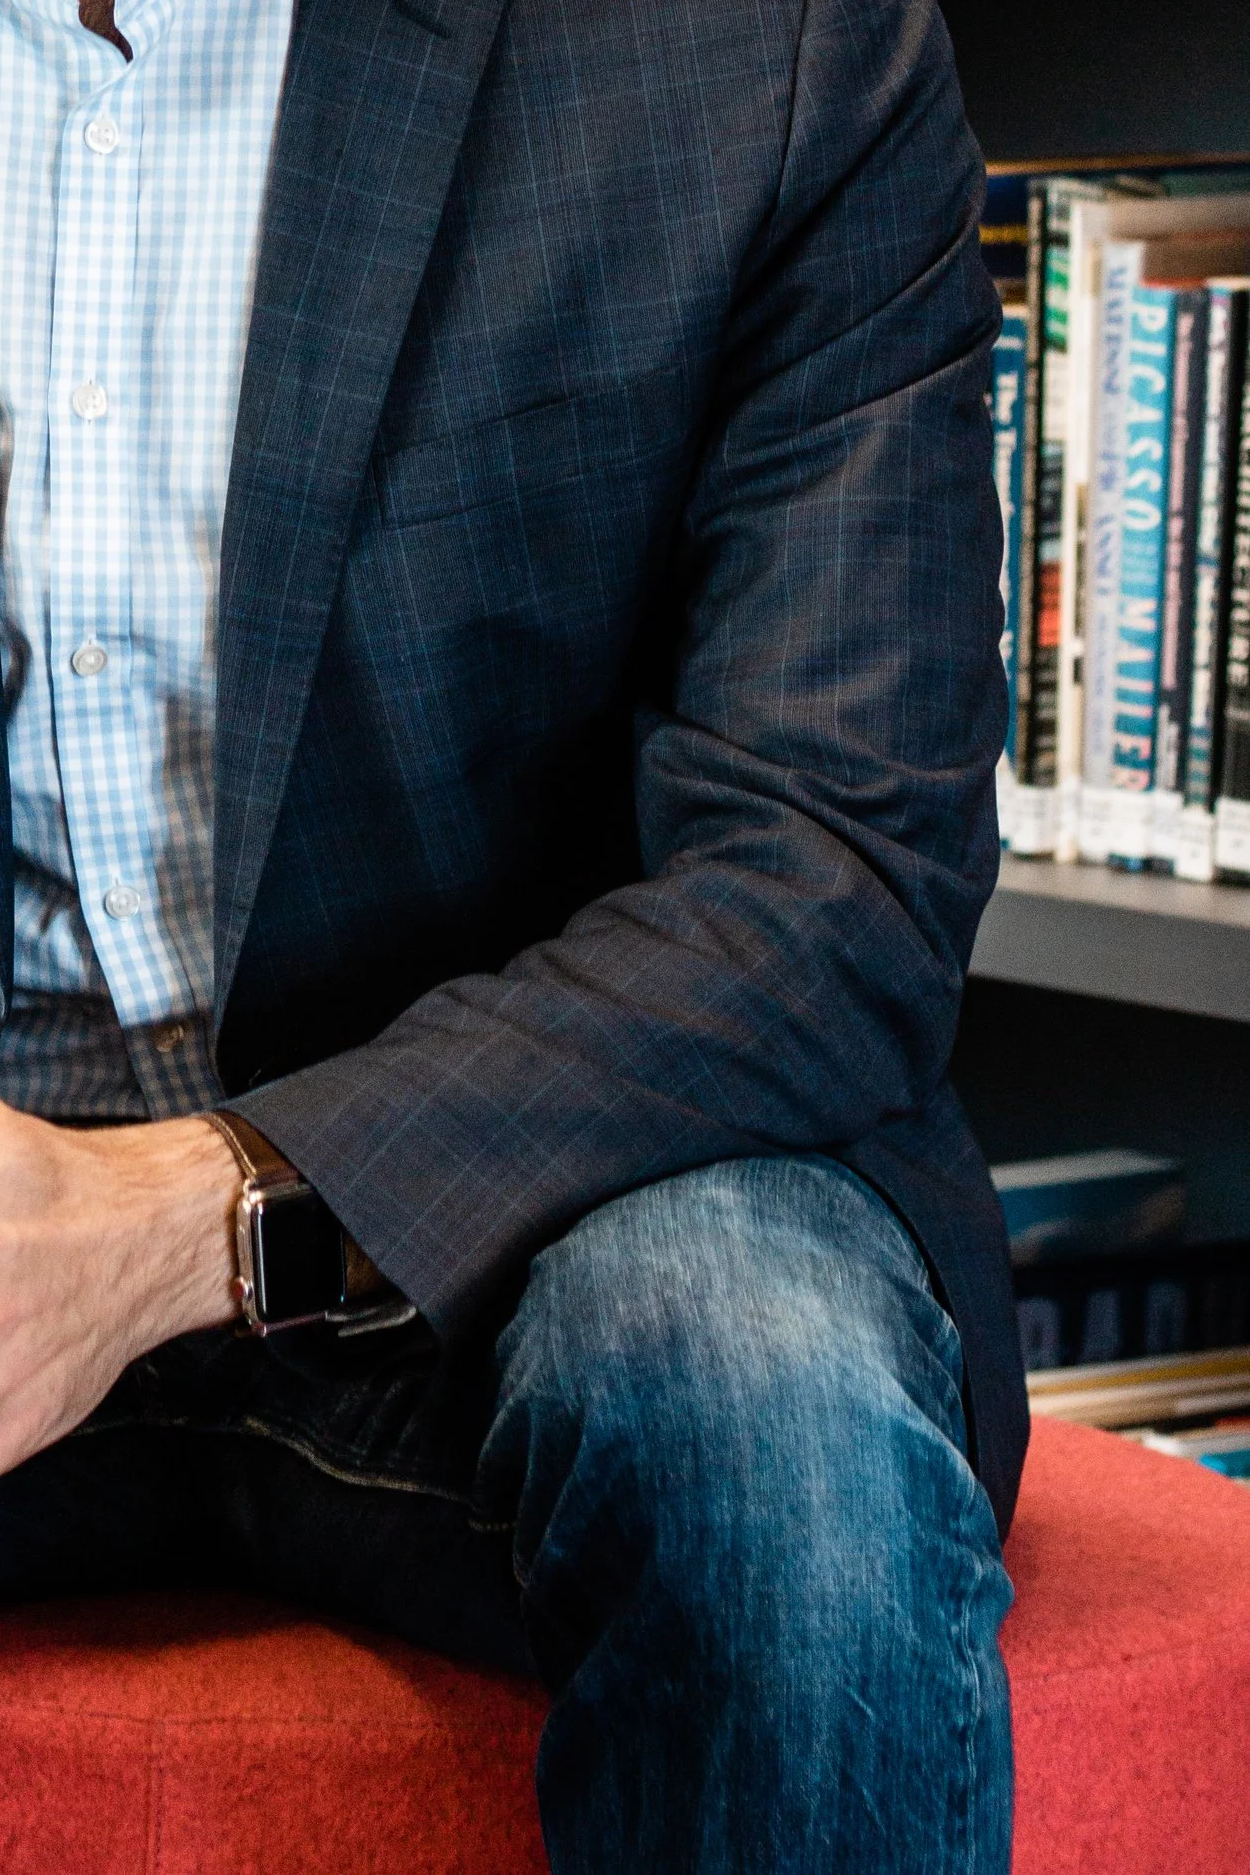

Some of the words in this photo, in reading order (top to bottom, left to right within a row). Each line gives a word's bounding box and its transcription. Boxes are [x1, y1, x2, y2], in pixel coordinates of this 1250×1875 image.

[998, 371, 1018, 424] The
[1121, 301, 1167, 531] PICASSO
[1110, 595, 1158, 792] MAILER
